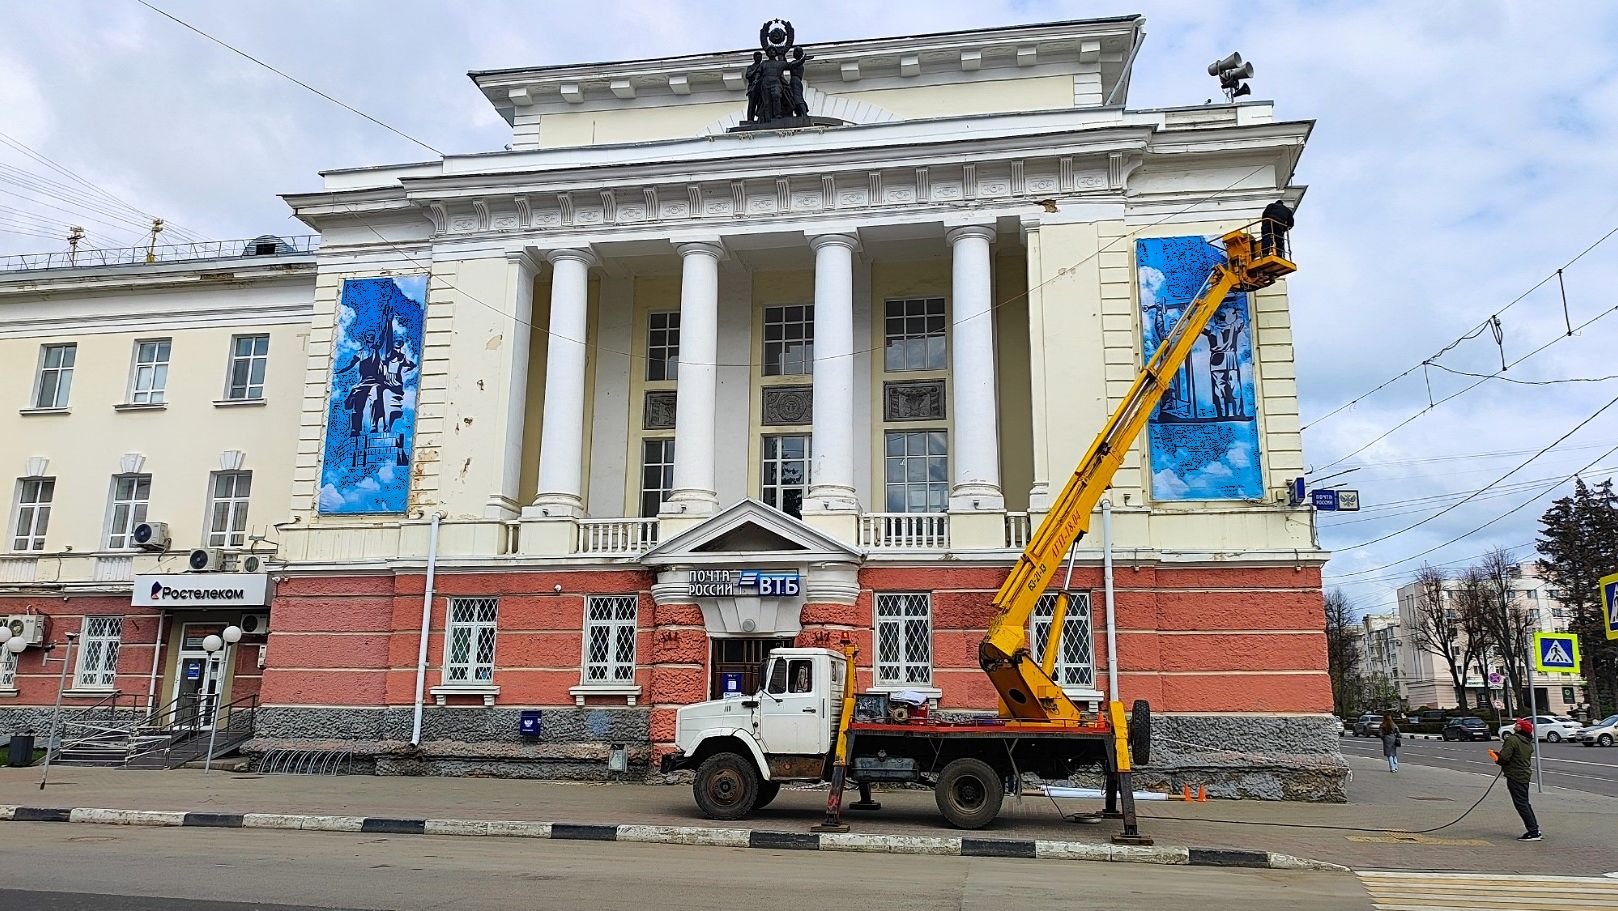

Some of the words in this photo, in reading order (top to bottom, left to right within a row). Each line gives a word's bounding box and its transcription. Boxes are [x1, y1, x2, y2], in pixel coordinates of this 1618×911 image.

[688, 570, 730, 582] ПОЧТА
[1028, 563, 1047, 592] 63-21-13
[688, 583, 734, 596] РОССИИ
[760, 576, 799, 595] ВТБ
[162, 586, 244, 600] Ростелеком
